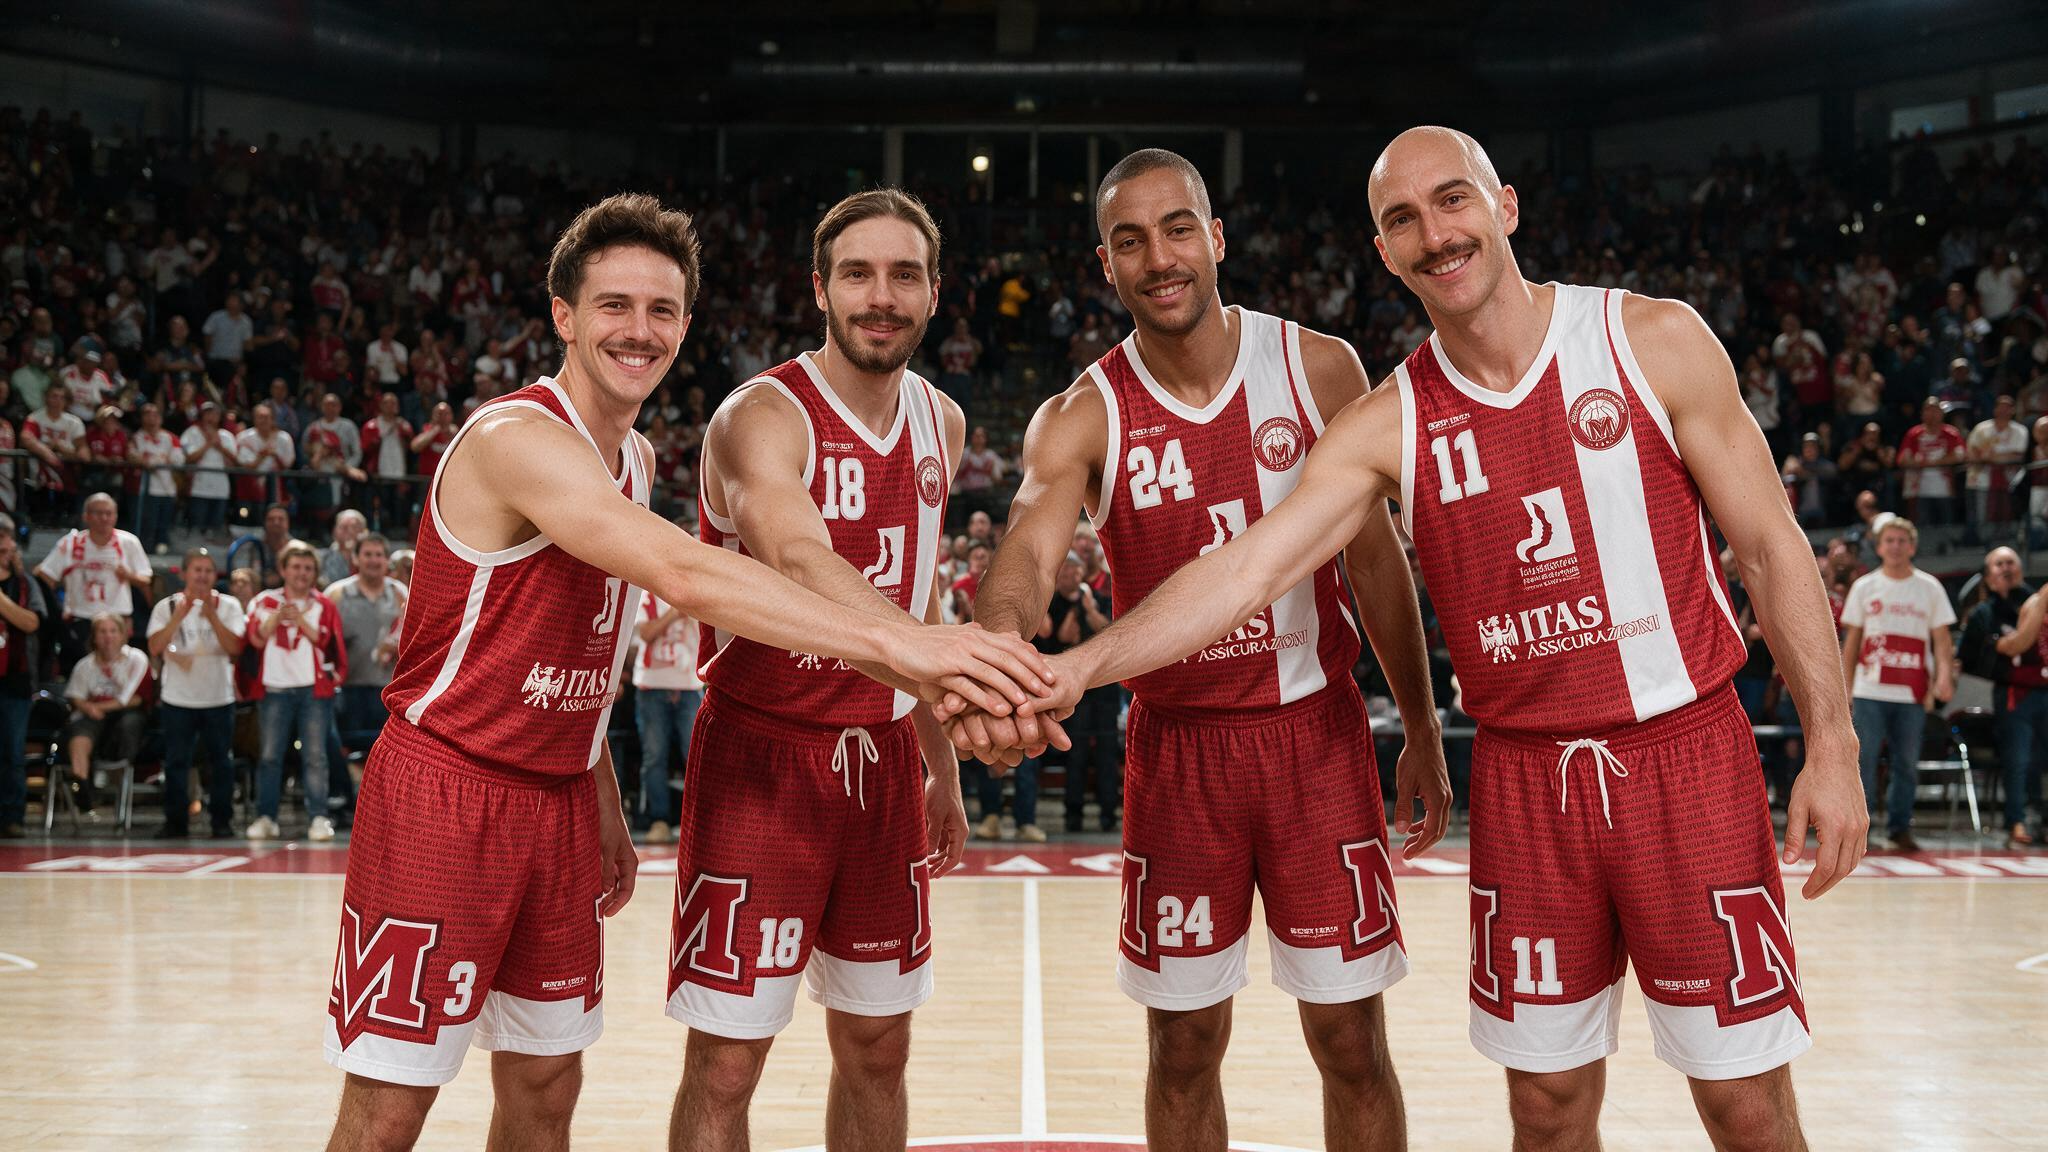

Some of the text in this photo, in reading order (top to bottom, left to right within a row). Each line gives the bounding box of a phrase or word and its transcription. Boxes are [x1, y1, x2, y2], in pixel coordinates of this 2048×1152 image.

[822, 457, 866, 521] 18
[1127, 438, 1195, 511] 24
[1431, 429, 1489, 505] 11
[1518, 595, 1603, 643] ITAS
[563, 666, 609, 697] ITAS
[756, 917, 804, 969] 18
[1157, 895, 1214, 947] 24
[330, 902, 438, 1029] M
[443, 961, 477, 1017] 3
[1511, 937, 1563, 996] 11
